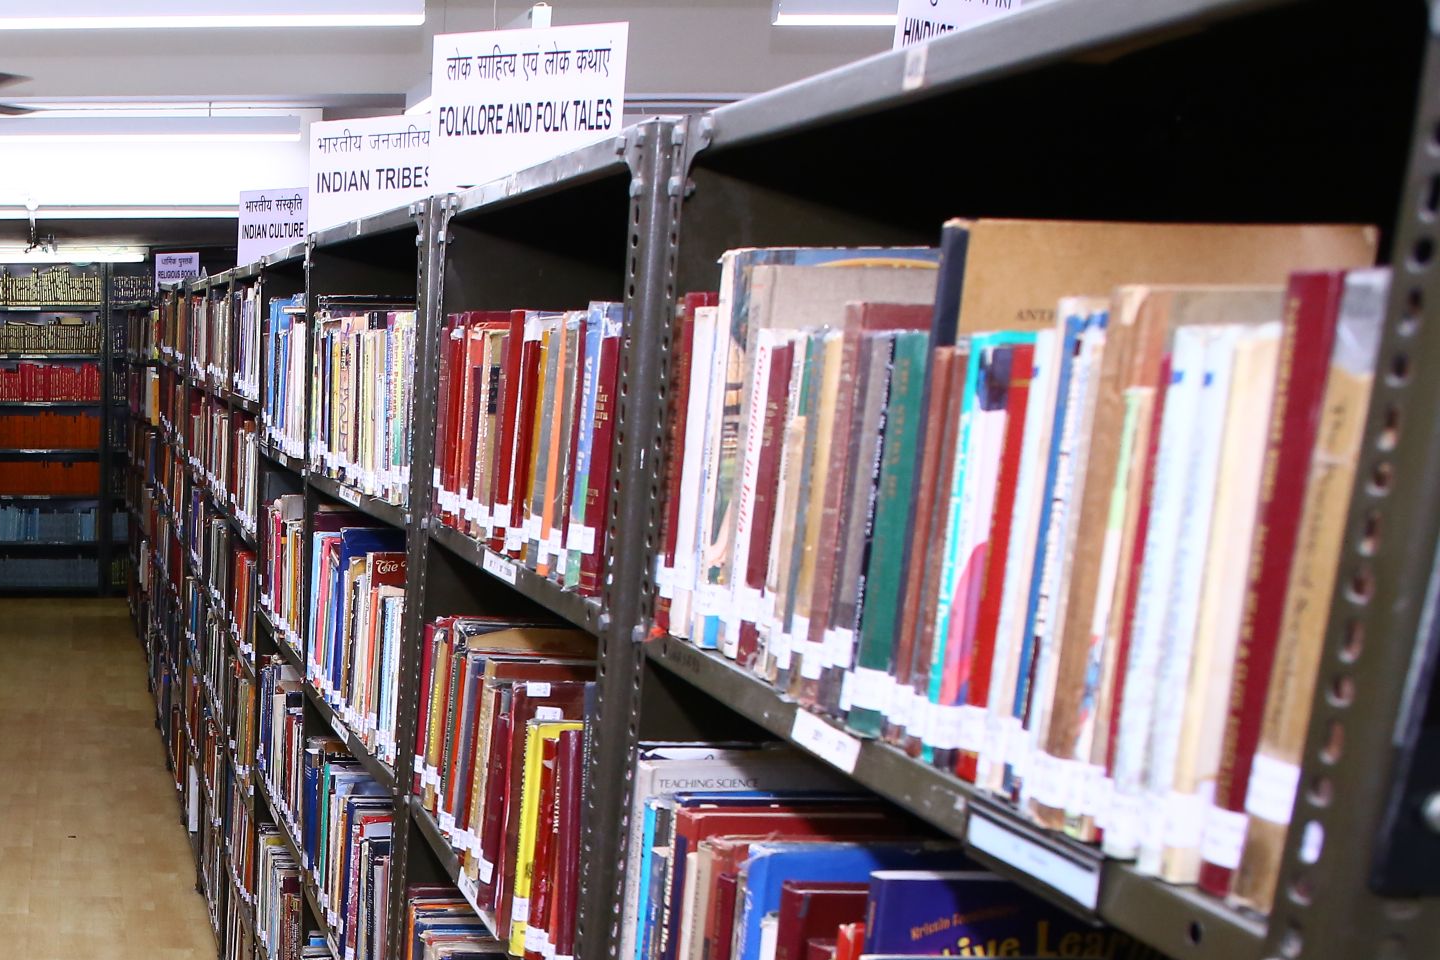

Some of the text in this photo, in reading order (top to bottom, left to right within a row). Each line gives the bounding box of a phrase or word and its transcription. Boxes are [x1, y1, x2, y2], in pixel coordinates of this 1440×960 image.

[446, 48, 471, 82] लोक
[477, 45, 516, 80] साहित्य
[523, 45, 541, 82] एवं
[544, 41, 572, 78] लोक
[438, 98, 612, 138] FOLKLORE AND FOLK TALES
[317, 129, 362, 155] भारतीय
[316, 169, 371, 194] INDIAN
[245, 193, 303, 216] भारतीय संस्कृति
[241, 222, 304, 240] INDIAN CULTURE
[158, 270, 180, 279] RELIGIOUS
[736, 345, 768, 534] Corruption in India
[659, 778, 759, 788] TEACHING SCIENCE
